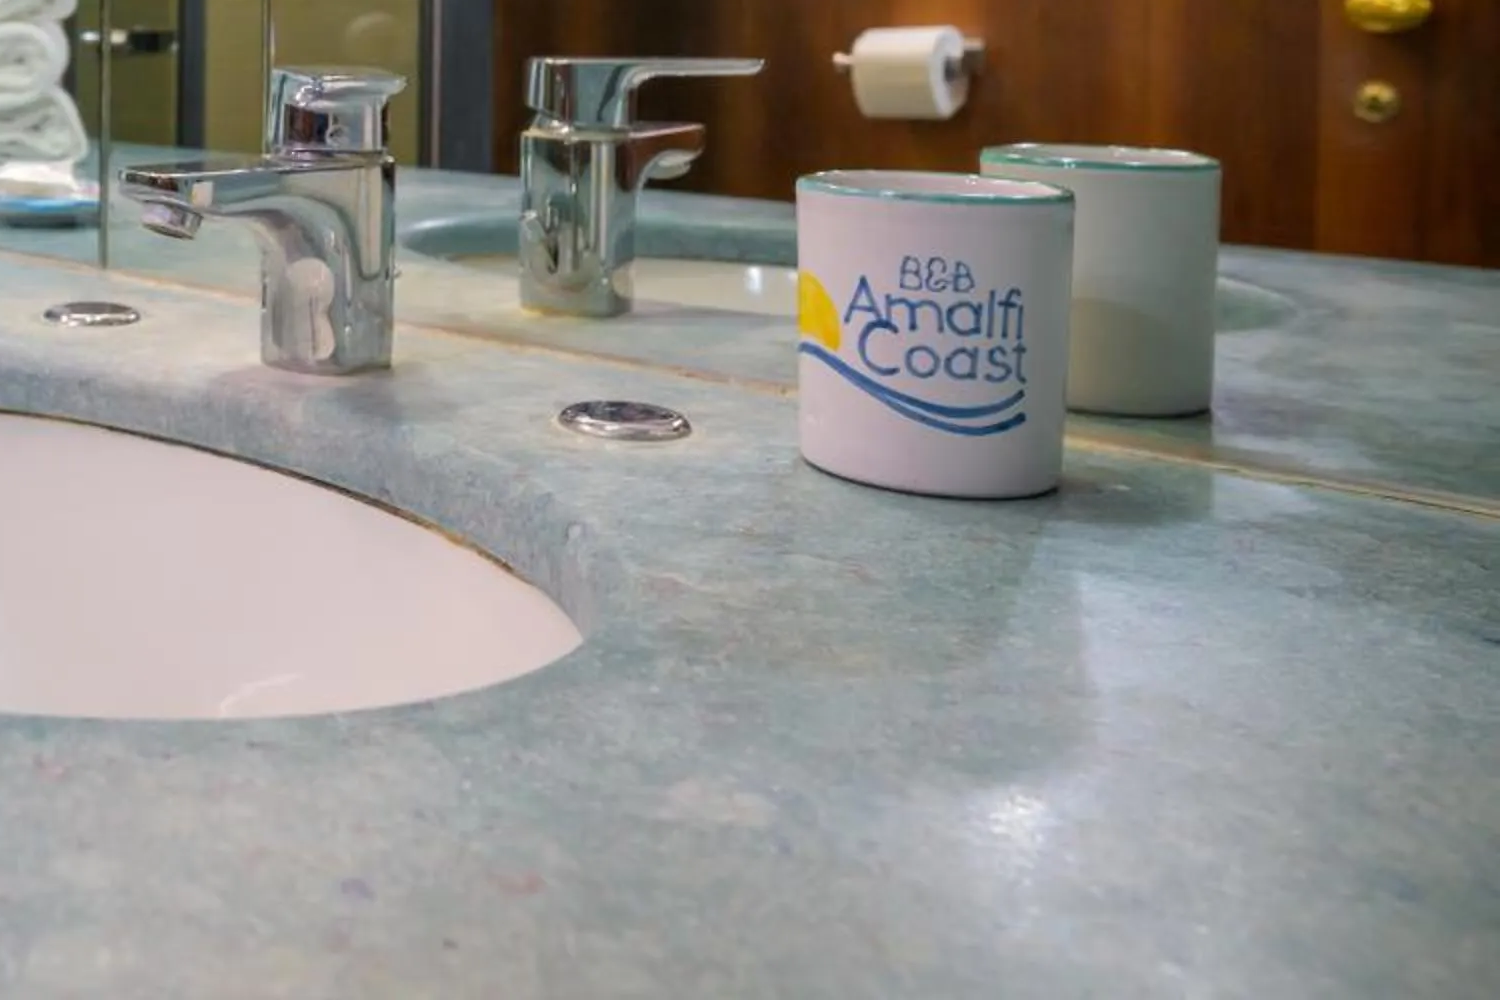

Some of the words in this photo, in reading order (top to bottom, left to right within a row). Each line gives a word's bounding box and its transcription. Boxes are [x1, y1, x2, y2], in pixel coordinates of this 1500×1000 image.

[901, 256, 975, 292] B&B
[845, 276, 1023, 339] Amalfi
[859, 320, 1026, 383] Coast
